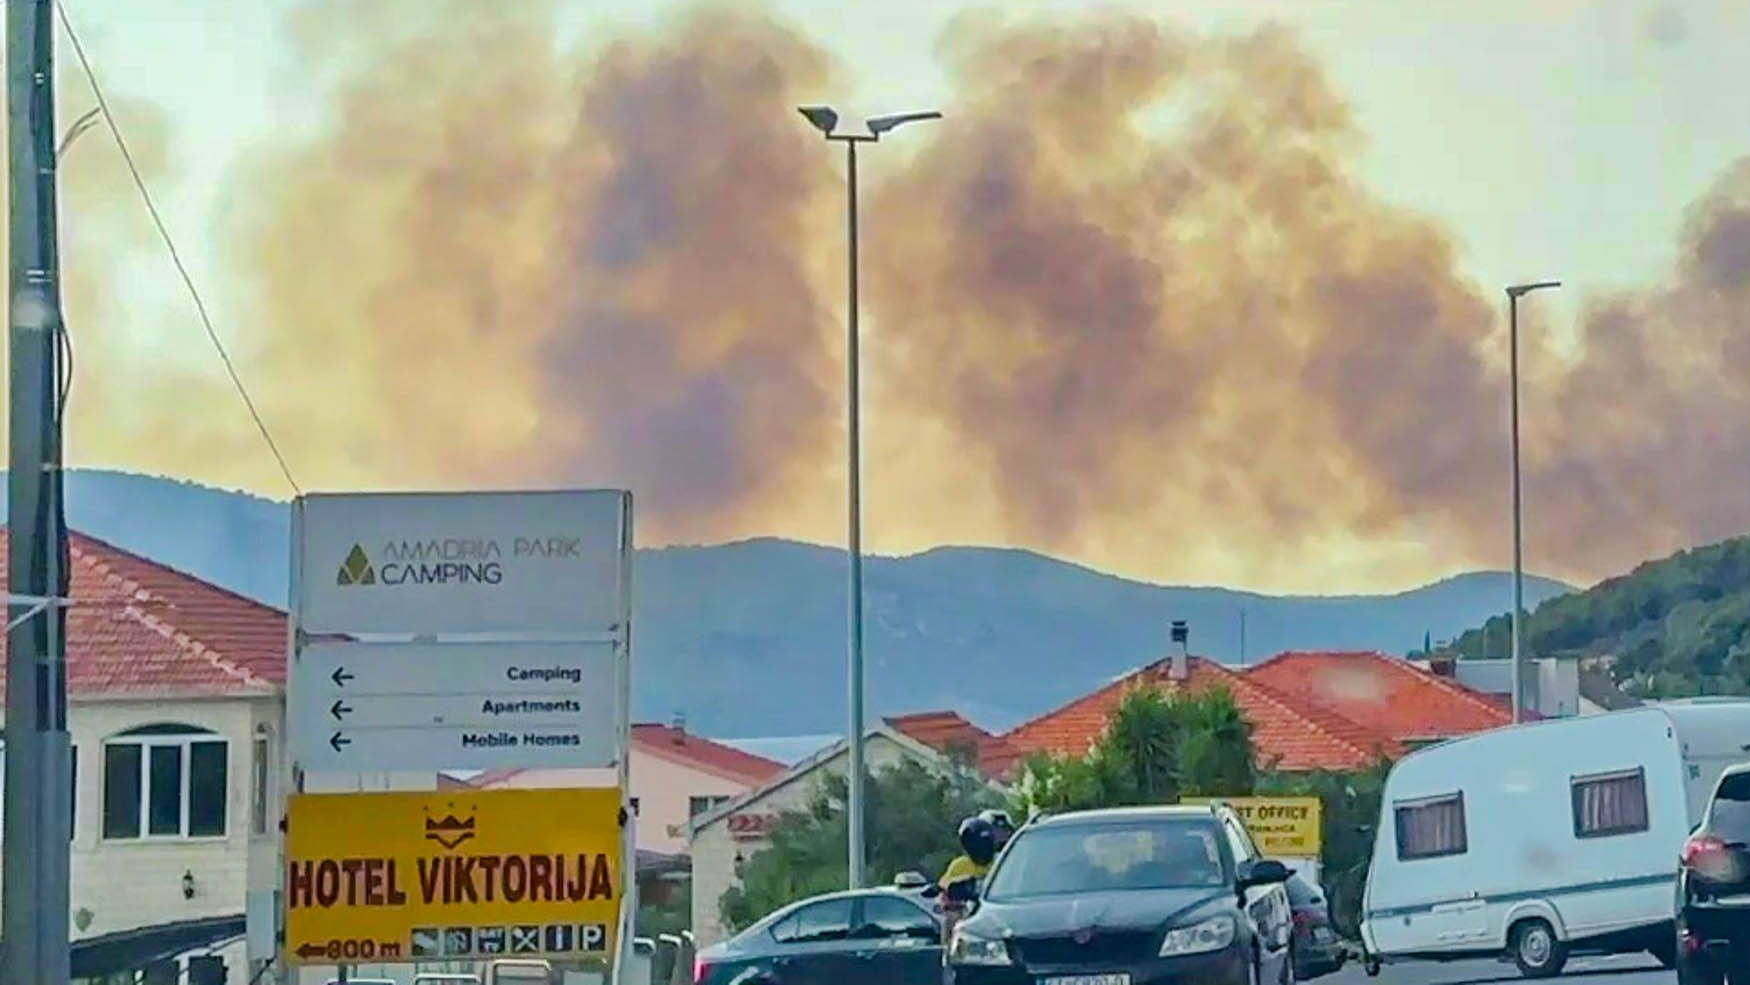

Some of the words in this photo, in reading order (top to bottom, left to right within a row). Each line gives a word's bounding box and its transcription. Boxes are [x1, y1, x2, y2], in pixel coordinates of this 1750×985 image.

[383, 539, 502, 558] AMADRIA
[513, 538, 581, 558] PARK
[381, 563, 502, 585] CAMPING
[507, 666, 582, 683] Camping
[481, 699, 581, 716] Apartments
[462, 733, 518, 747] Mobile
[523, 733, 581, 747] Homes
[288, 858, 407, 909] HOTEL
[417, 853, 613, 905] VIKTORIJA
